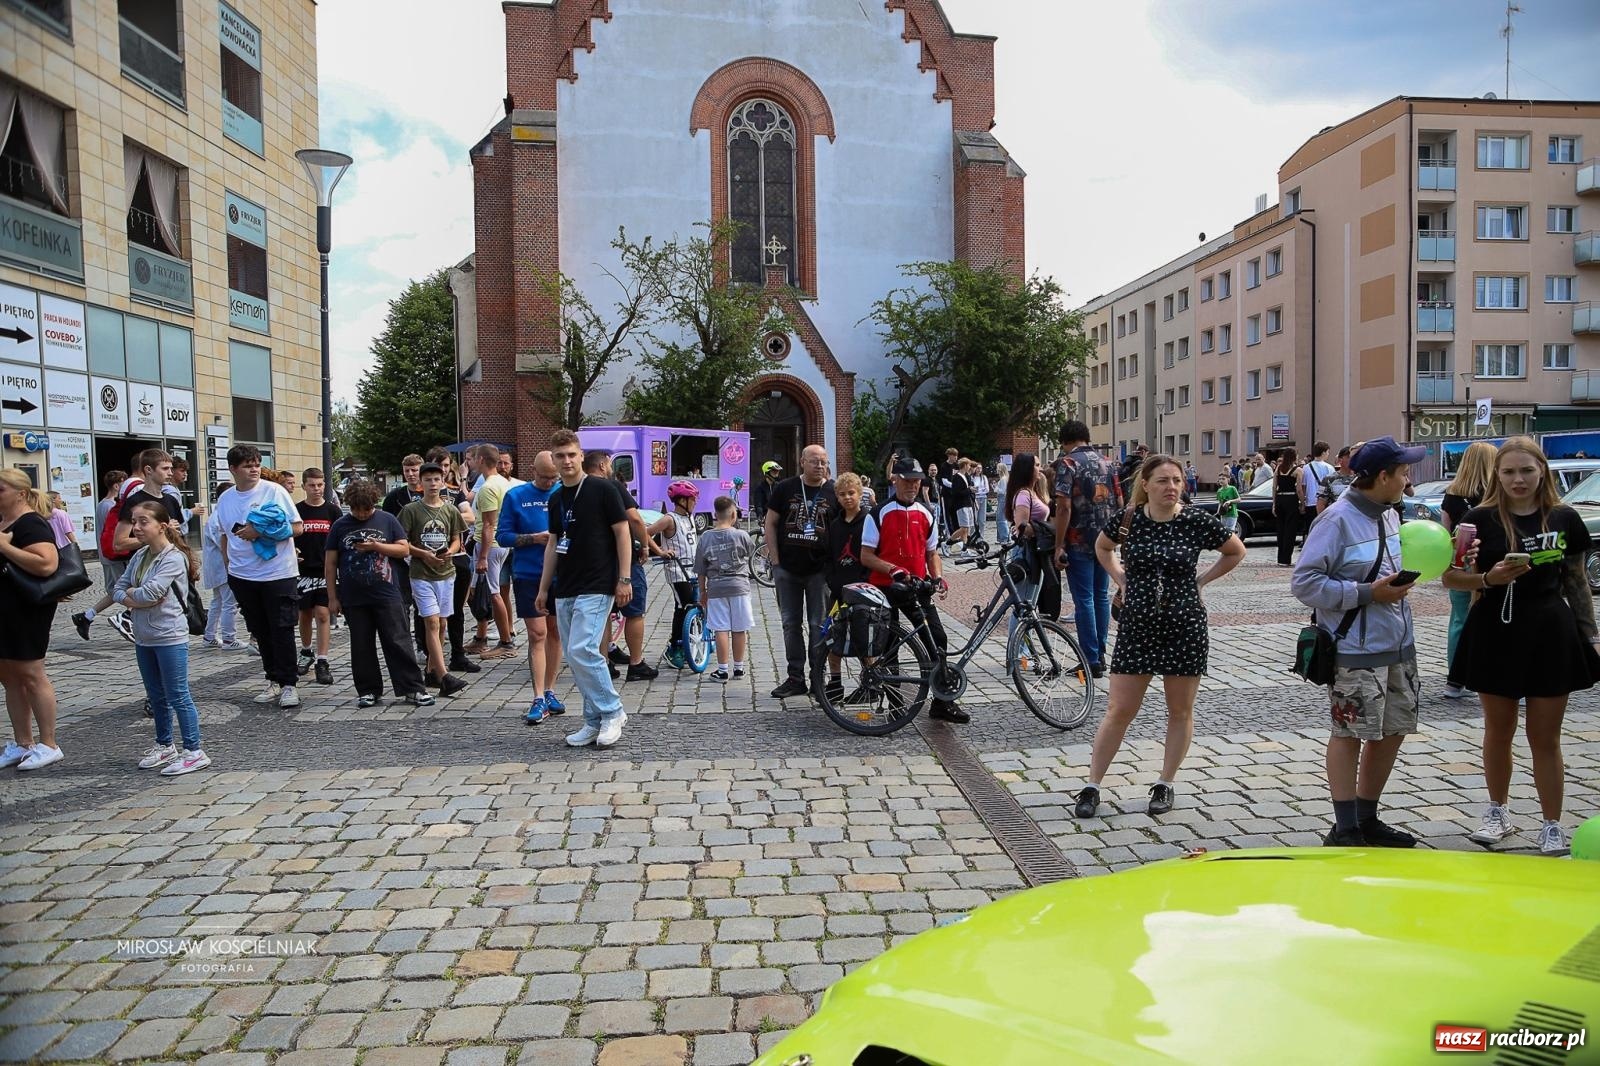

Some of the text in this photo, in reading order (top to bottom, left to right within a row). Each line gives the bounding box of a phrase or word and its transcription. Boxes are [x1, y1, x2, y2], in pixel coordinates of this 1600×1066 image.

[221, 10, 256, 44] KANCELARIA
[221, 25, 257, 59] ADWOKACKA
[241, 210, 262, 227] FRYZJER
[2, 215, 72, 257] KOFEINKA
[153, 264, 186, 283] FRYZJER
[4, 304, 35, 320] PIĘTRO
[45, 329, 76, 343] COVEBO
[2, 375, 37, 390] I PIĘTRO
[166, 408, 190, 423] LODY
[1417, 416, 1499, 437] STELLA
[303, 523, 331, 532] preme
[1536, 531, 1567, 550] 776
